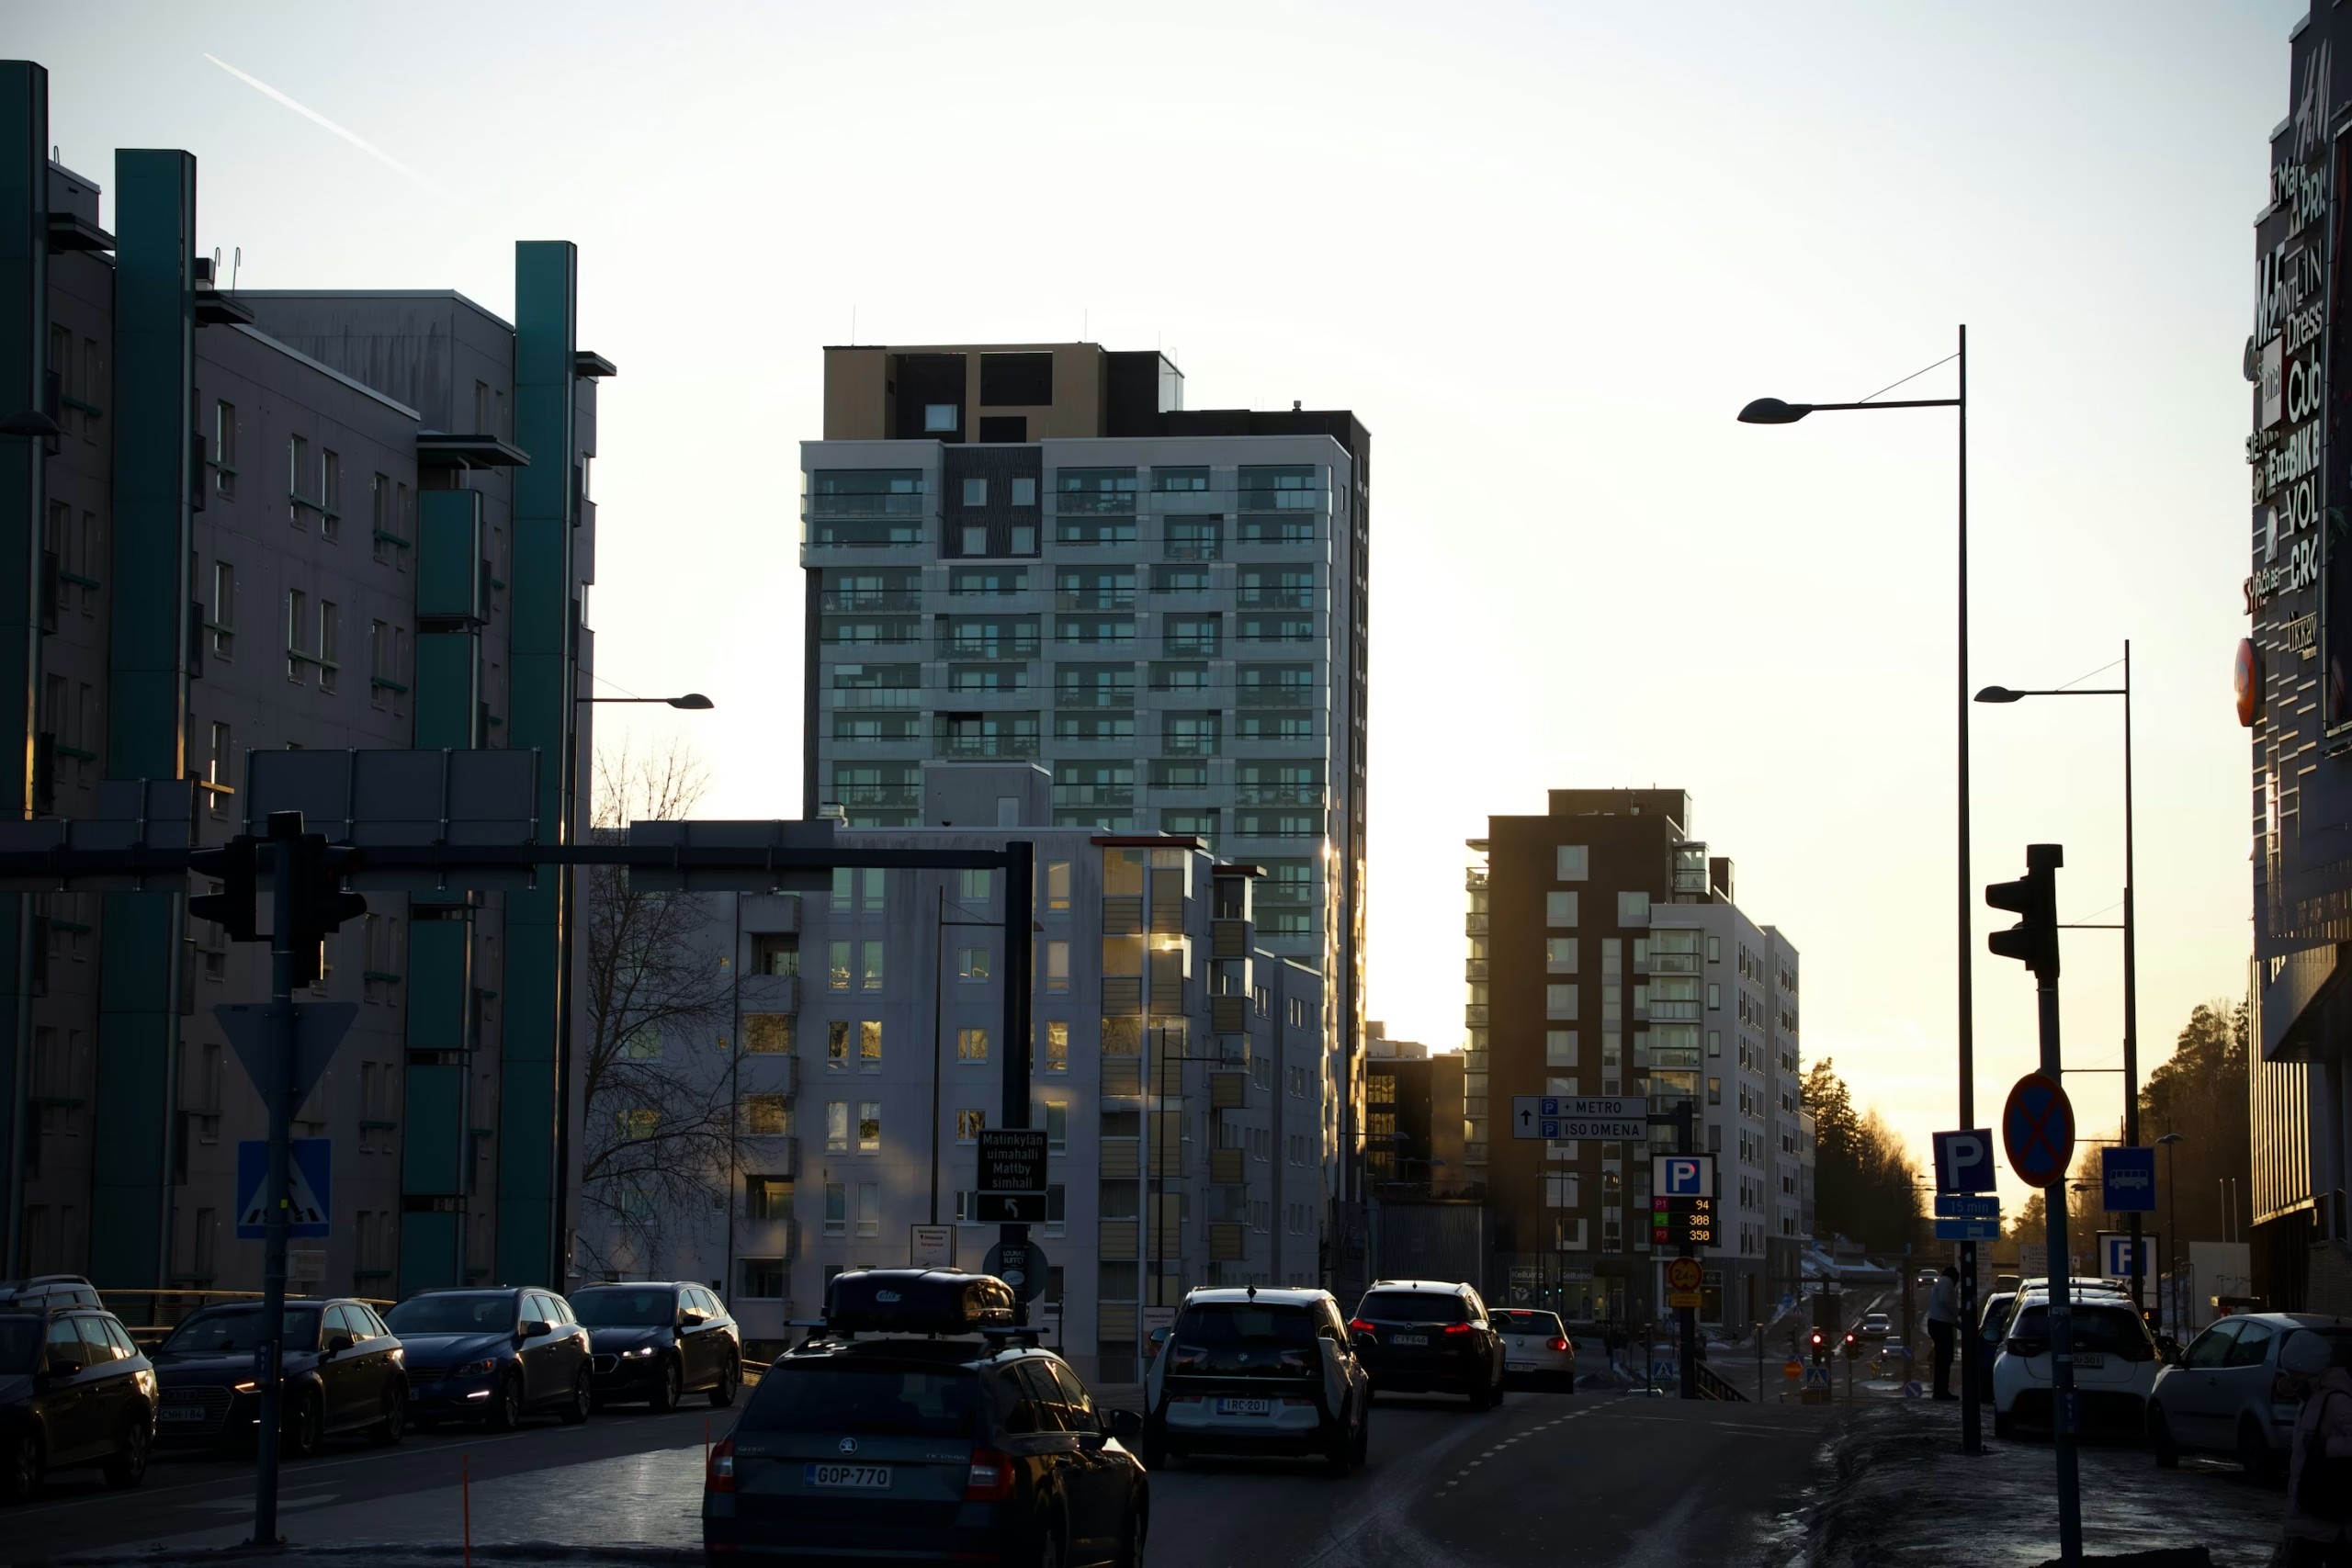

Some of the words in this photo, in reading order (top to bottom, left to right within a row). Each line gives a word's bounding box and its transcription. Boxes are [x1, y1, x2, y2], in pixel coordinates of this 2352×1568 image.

[1576, 1101, 1623, 1114] METRO
[1565, 1123, 1587, 1136] ISO
[1590, 1123, 1640, 1136] OMENA
[982, 1134, 1044, 1147] Matinkylän
[986, 1147, 1039, 1160] uimahalli
[992, 1162, 1032, 1176] Mattby
[1945, 1135, 1984, 1190] P
[1672, 1161, 1696, 1192] P
[991, 1177, 1034, 1190] simhall
[1656, 1200, 1668, 1209] P1
[1695, 1200, 1710, 1211] 94
[1950, 1201, 1964, 1213] 15
[1966, 1201, 1990, 1213] min
[1689, 1214, 1711, 1226] 308
[1656, 1230, 1668, 1239] P3
[1689, 1230, 1711, 1242] 350
[817, 1466, 888, 1486] GOP-770
